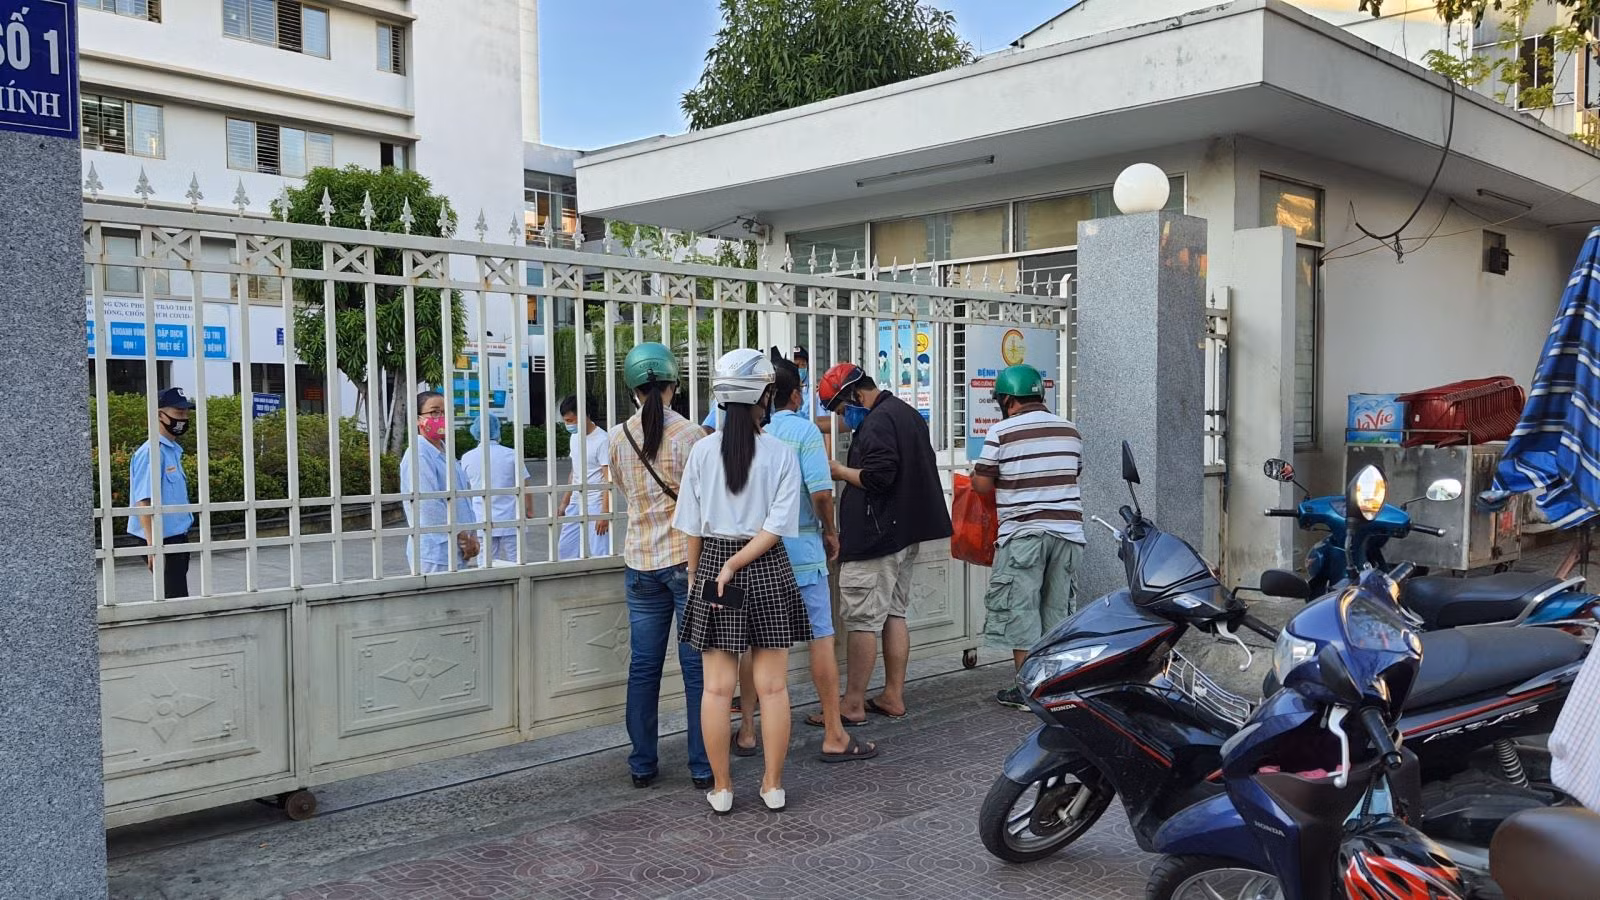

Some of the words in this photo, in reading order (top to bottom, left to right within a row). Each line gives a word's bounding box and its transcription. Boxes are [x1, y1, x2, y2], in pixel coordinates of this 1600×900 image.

[43, 29, 60, 75] 1
[1050, 703, 1077, 712] HONDA
[1253, 820, 1286, 837] HONDA
